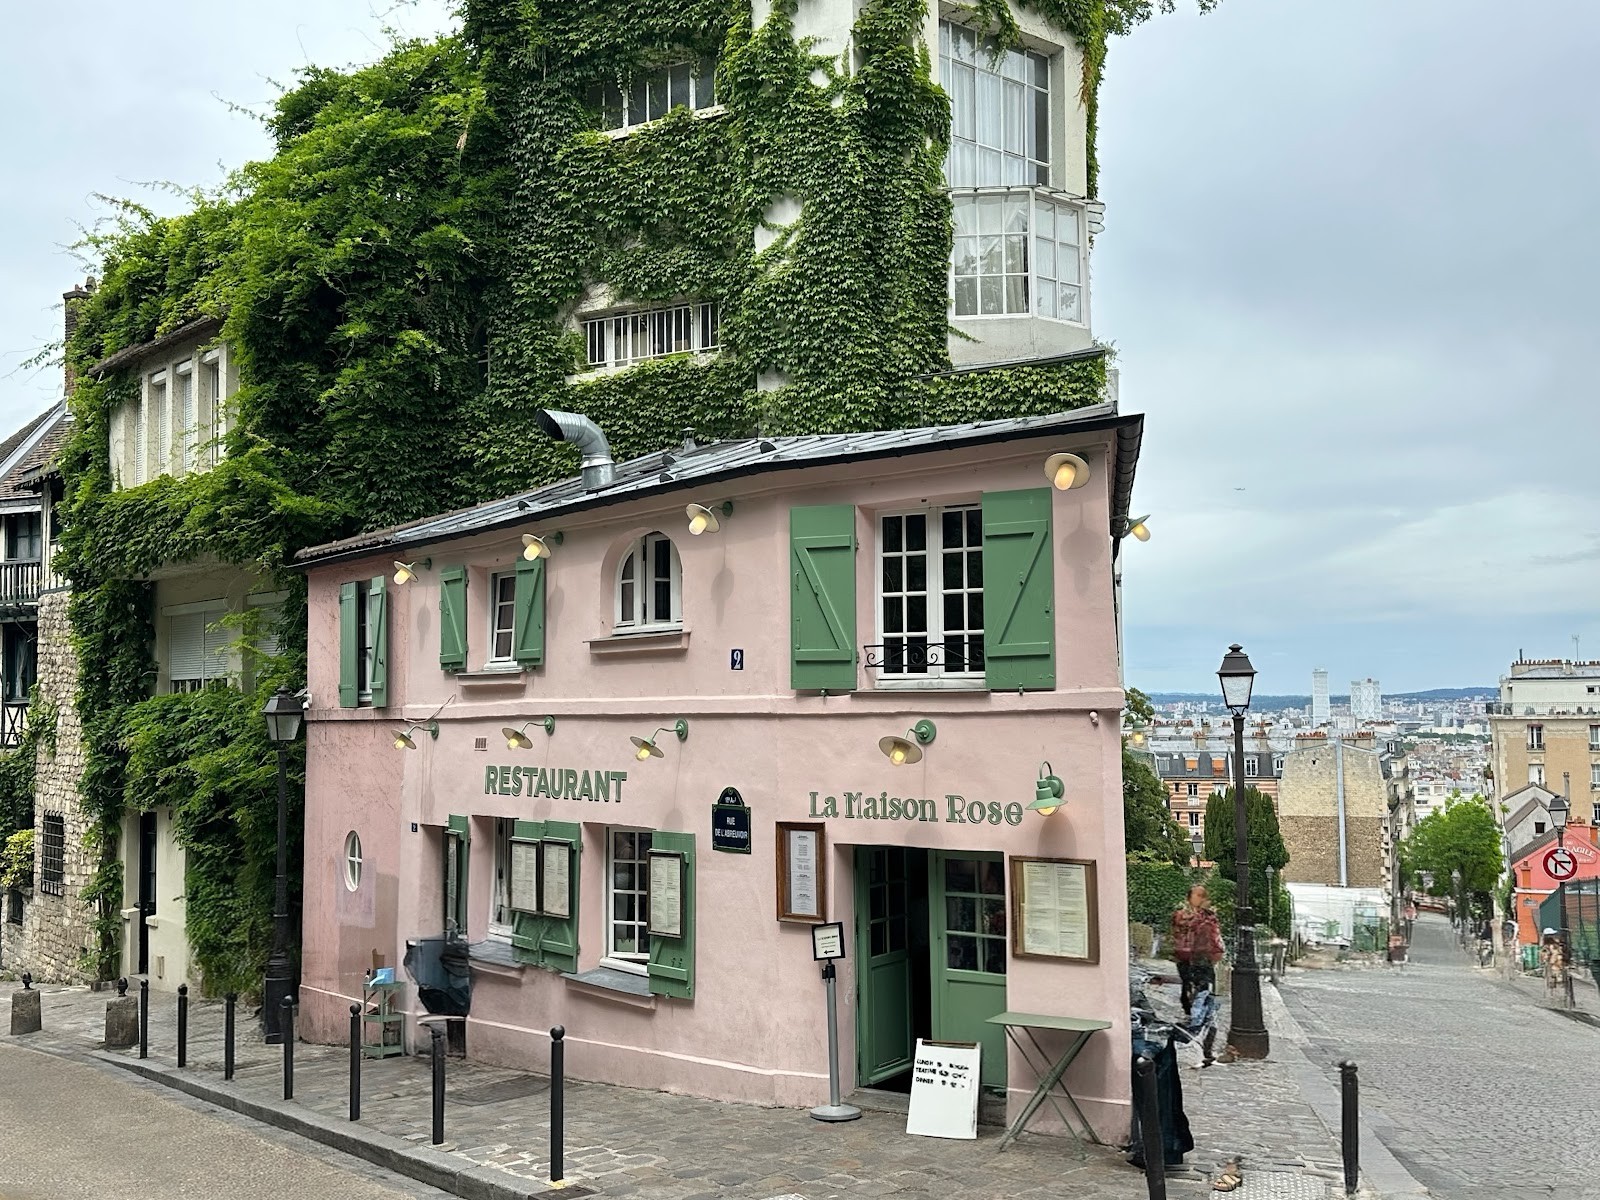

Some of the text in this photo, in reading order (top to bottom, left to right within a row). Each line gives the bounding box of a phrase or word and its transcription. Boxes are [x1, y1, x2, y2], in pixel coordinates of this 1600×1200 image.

[733, 650, 741, 669] 2
[485, 765, 627, 803] RESTAURANT
[726, 816, 735, 825] RUE
[809, 791, 1023, 826] La Maison Rose
